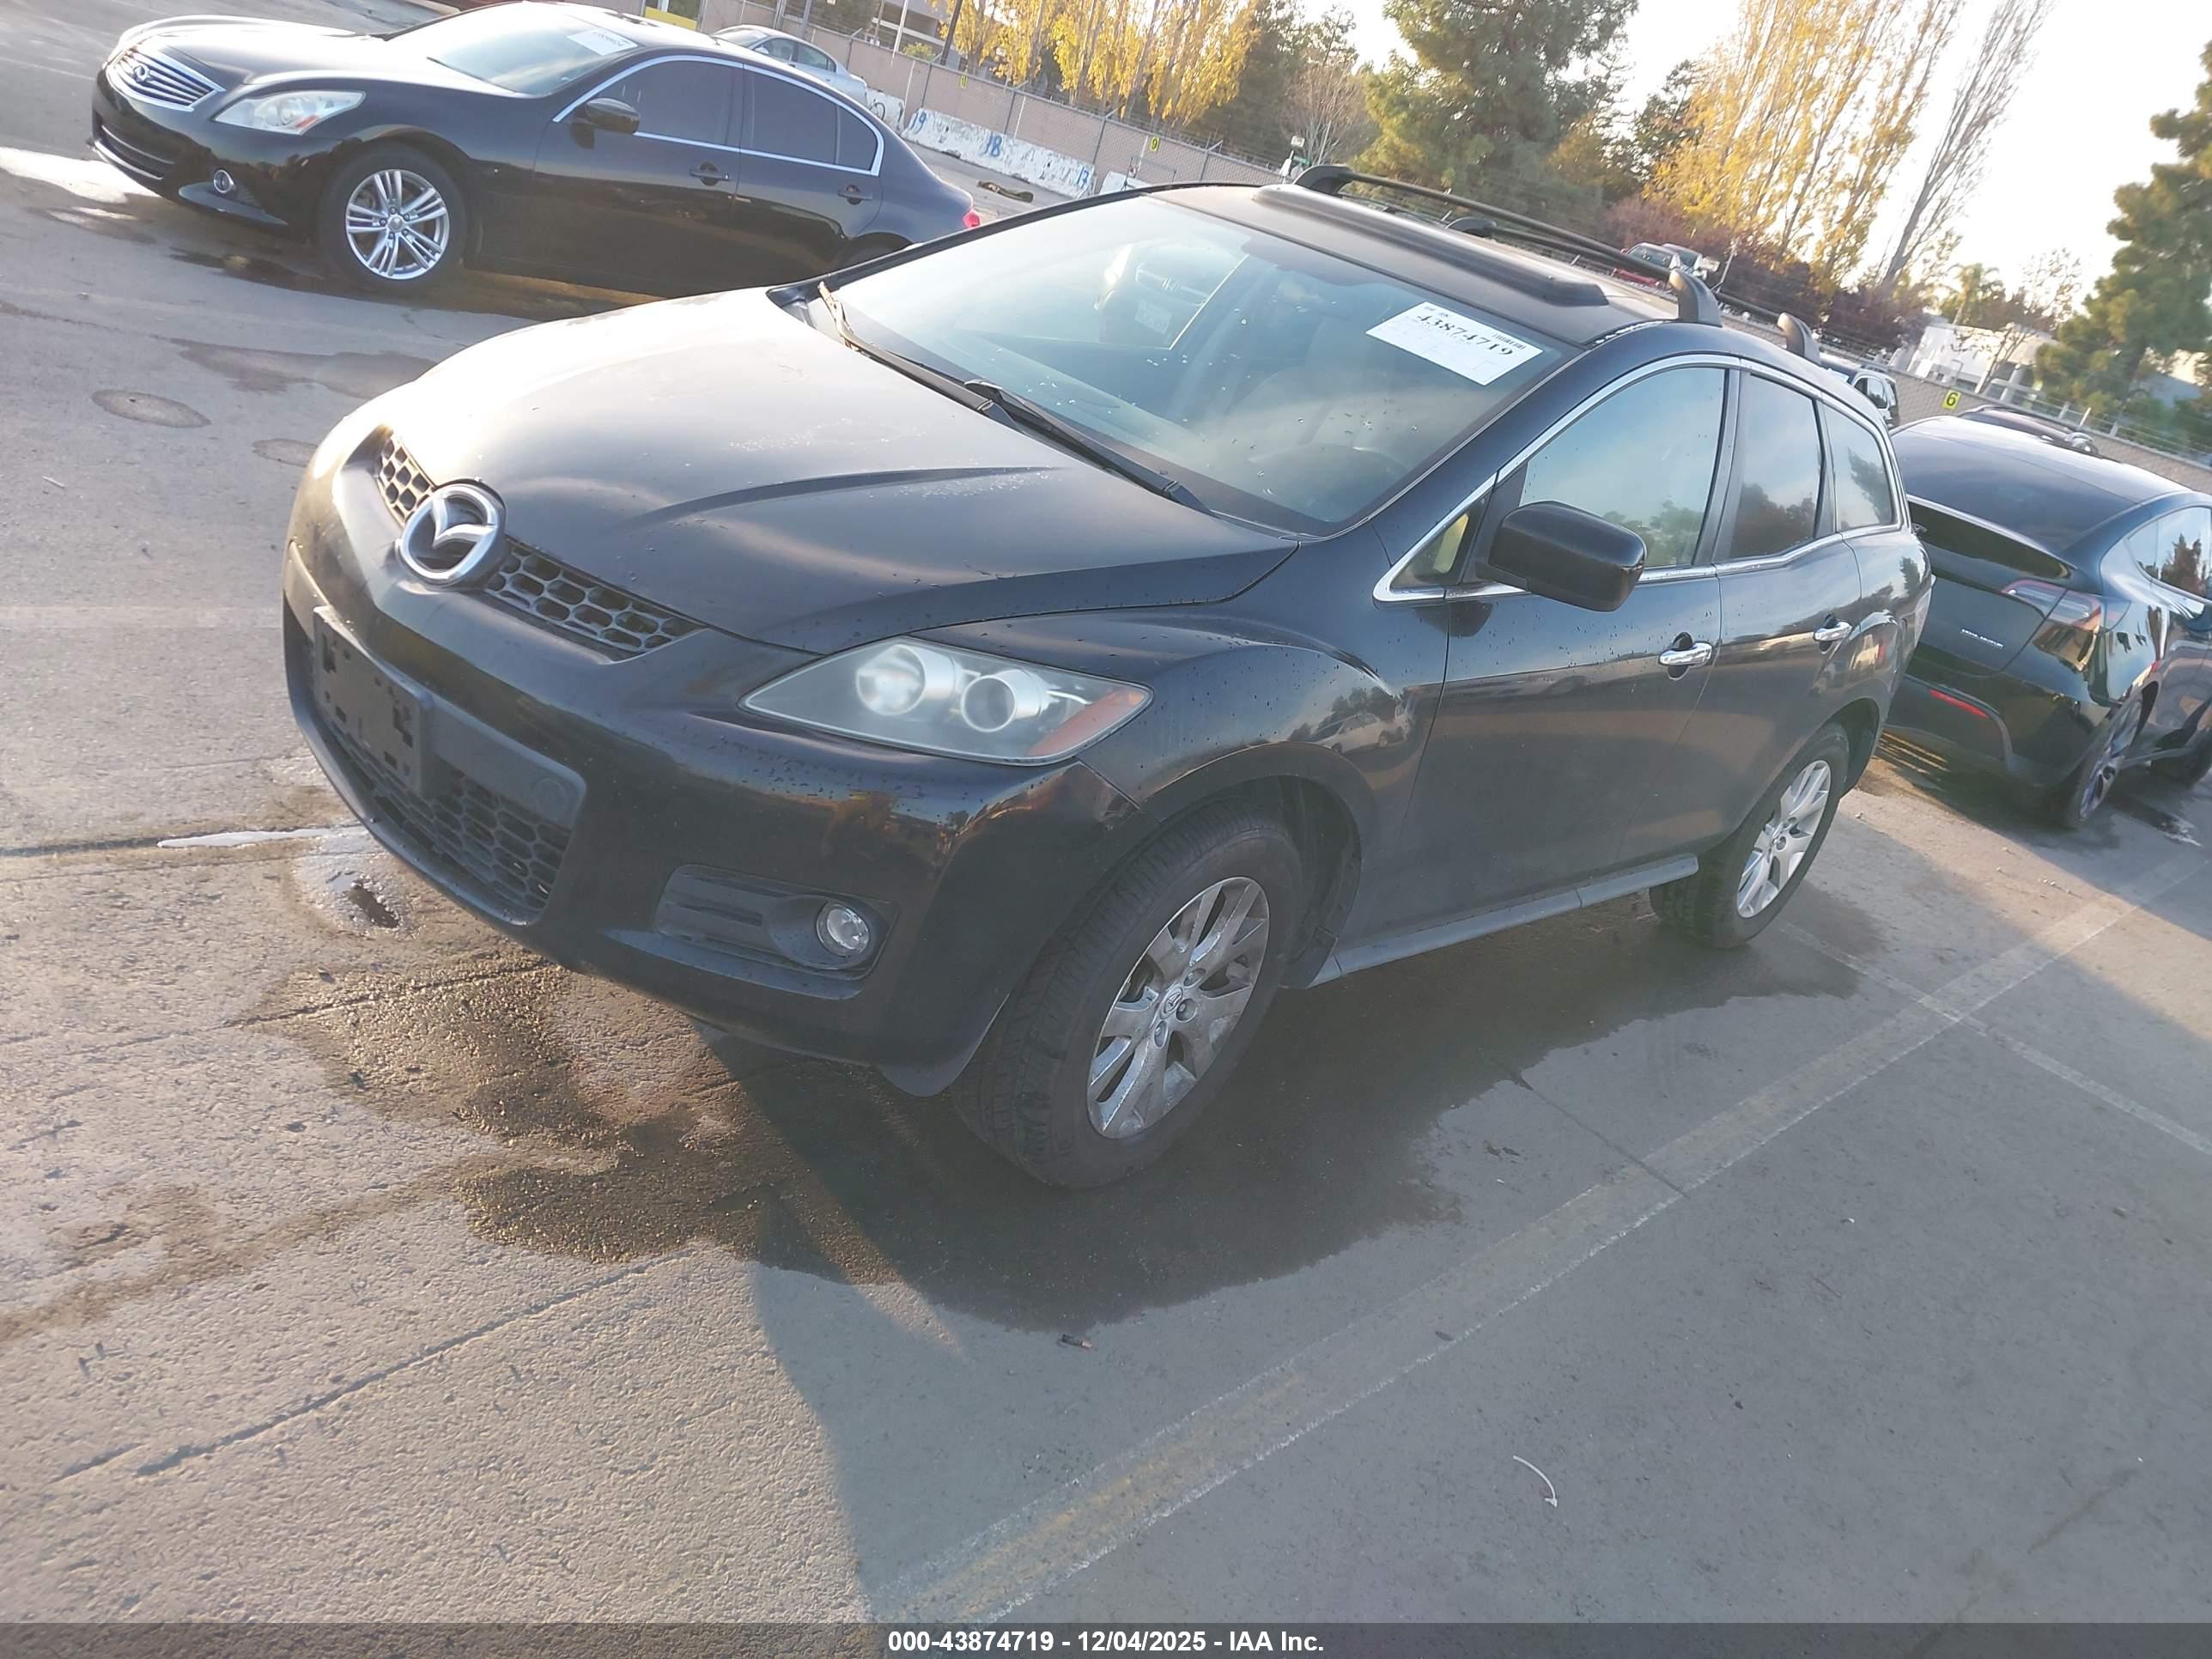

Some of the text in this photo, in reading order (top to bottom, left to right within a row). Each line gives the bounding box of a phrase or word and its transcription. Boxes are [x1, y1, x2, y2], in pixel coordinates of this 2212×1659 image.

[910, 111, 927, 134] 19
[981, 131, 1002, 157] 18
[1151, 137, 1158, 150] 9
[1417, 313, 1514, 356] 43874719
[1946, 392, 1959, 406] 6
